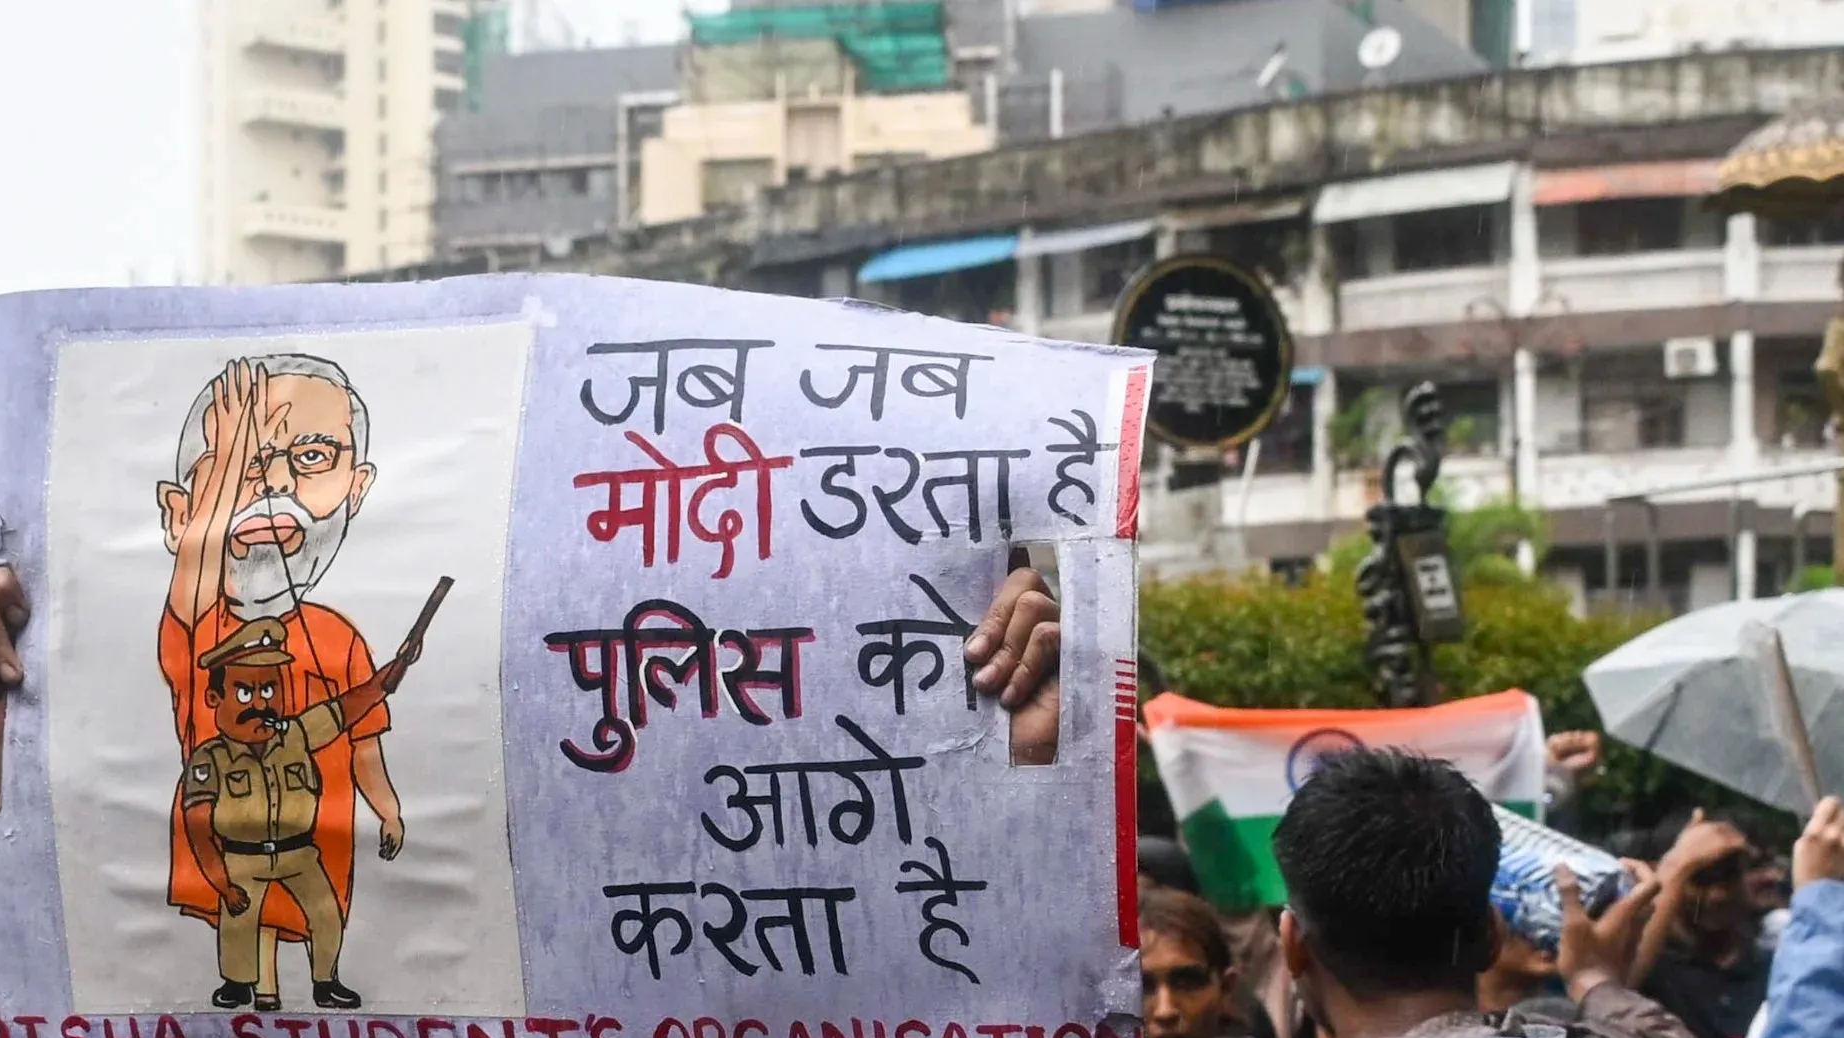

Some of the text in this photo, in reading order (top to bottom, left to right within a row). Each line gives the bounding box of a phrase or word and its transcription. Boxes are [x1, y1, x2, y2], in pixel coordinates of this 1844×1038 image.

[580, 339, 994, 434] जब जब
[572, 409, 1116, 579] मोदी डरता है
[544, 573, 978, 773] पुलिस को
[700, 714, 925, 853] आगे
[602, 836, 988, 984] करता है
